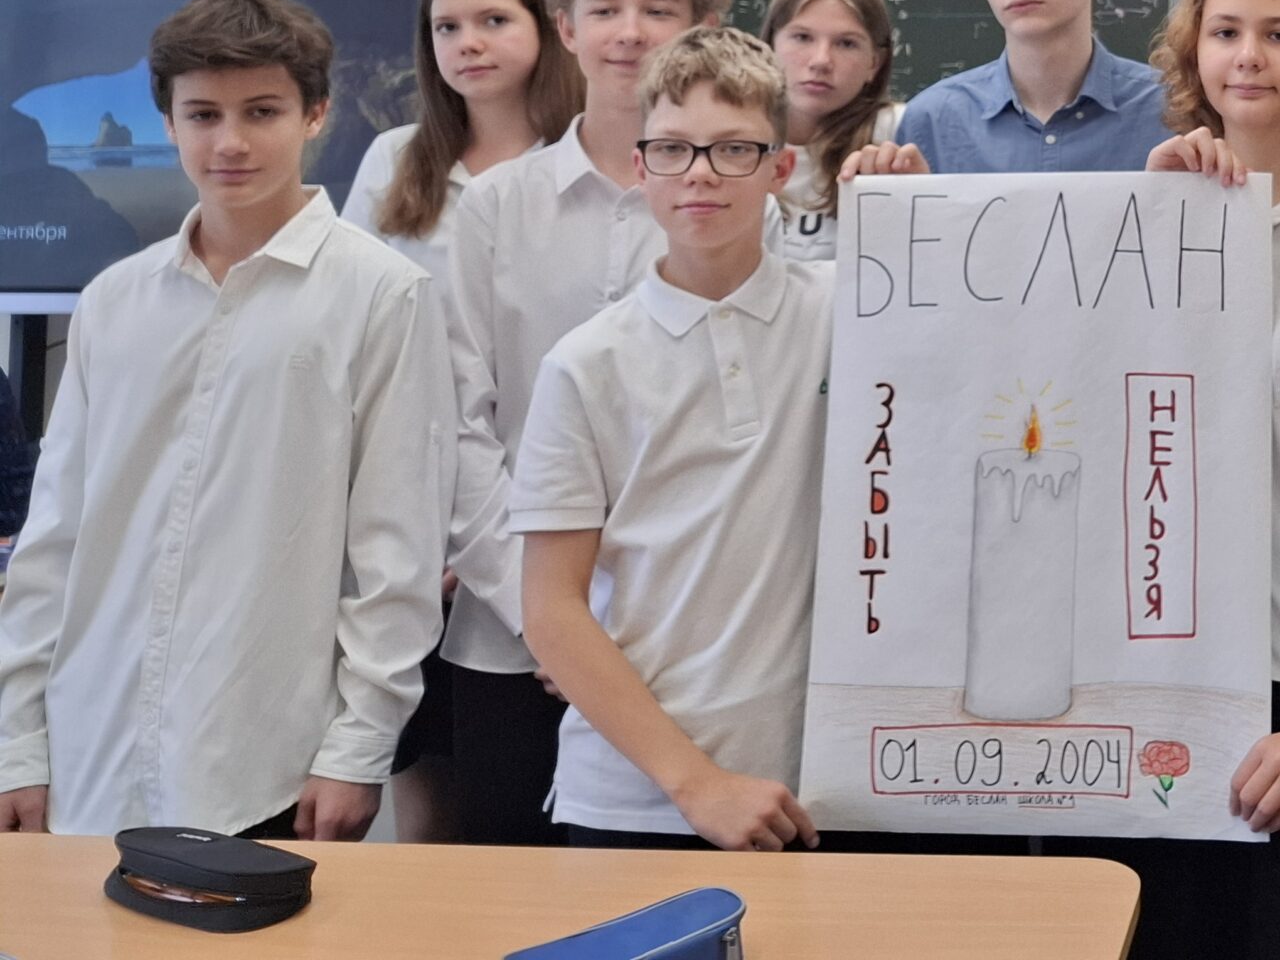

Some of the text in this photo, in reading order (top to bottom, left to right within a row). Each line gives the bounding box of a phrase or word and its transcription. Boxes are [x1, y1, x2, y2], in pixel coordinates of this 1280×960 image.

[856, 192, 1228, 318] БЕСЛАН
[859, 382, 896, 635] ЗАБЫТЬ
[1143, 389, 1176, 621] НЕЛЬЗЯ
[924, 794, 960, 806] ГОРОД
[966, 794, 1008, 806] БЕСЛАН
